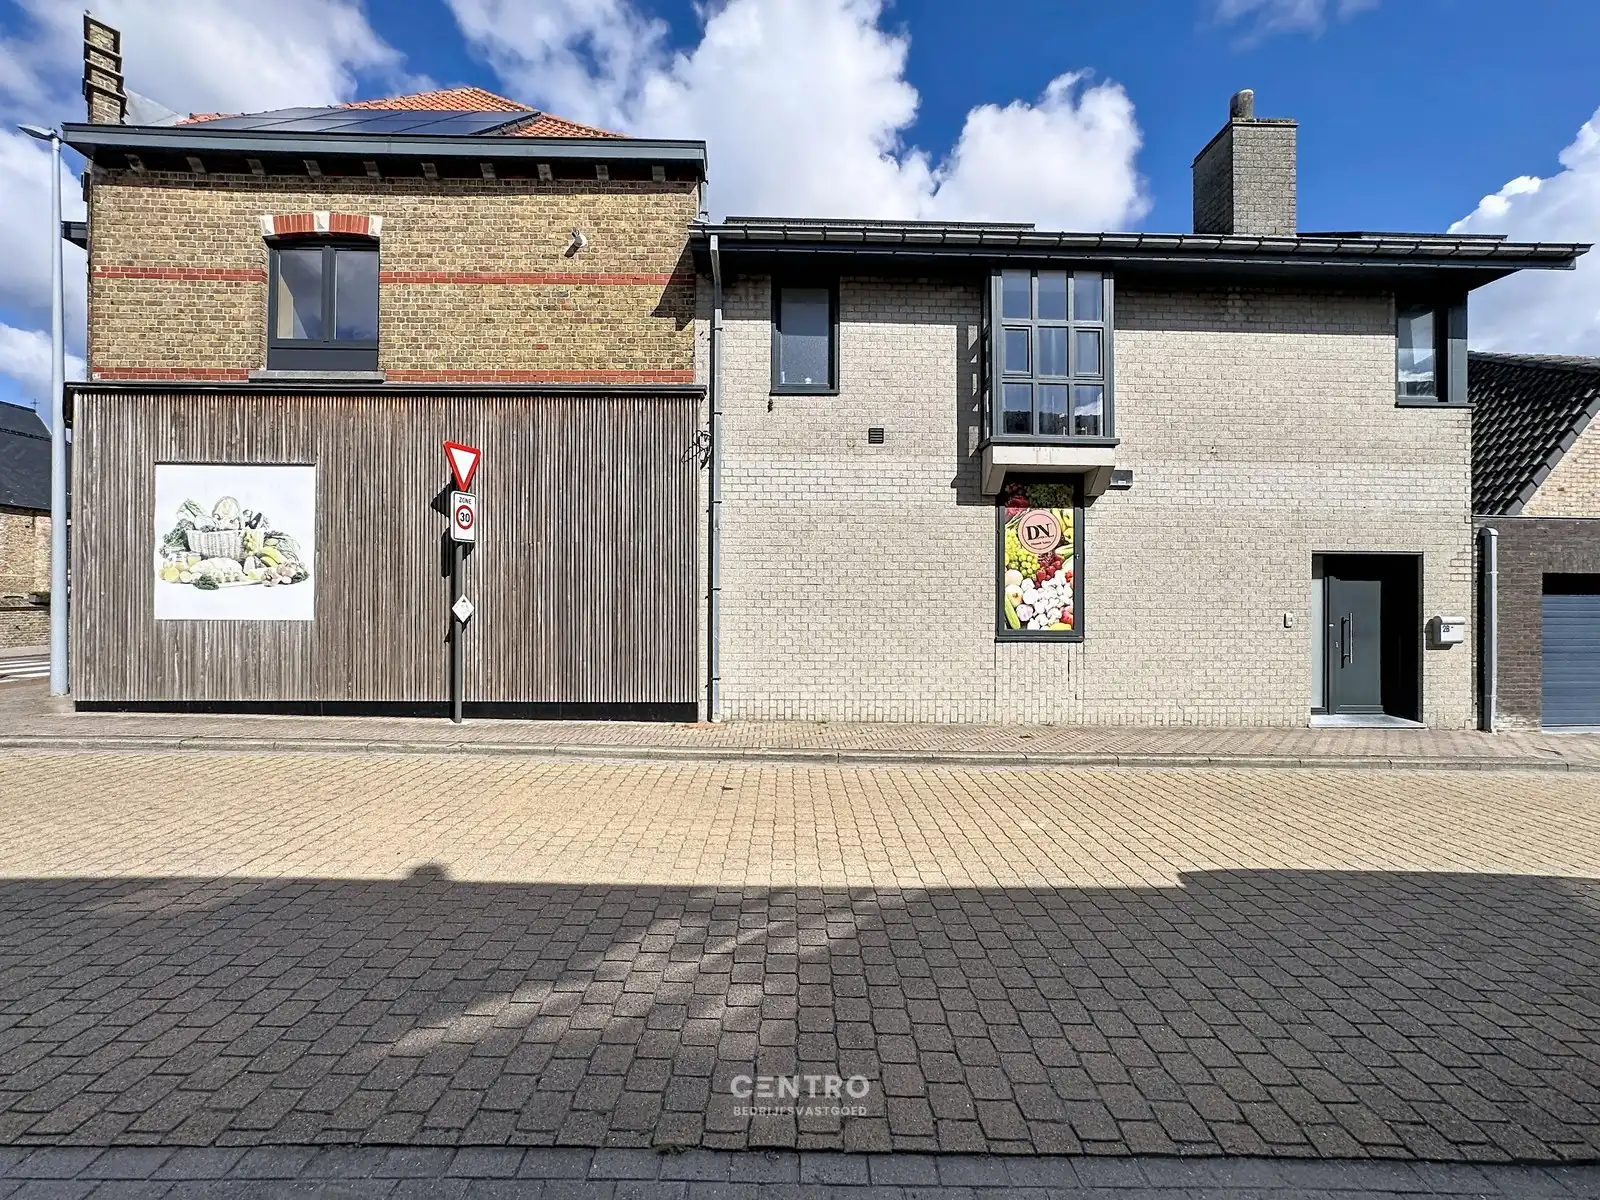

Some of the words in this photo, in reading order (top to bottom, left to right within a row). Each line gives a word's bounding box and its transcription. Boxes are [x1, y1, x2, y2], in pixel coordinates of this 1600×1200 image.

[459, 496, 472, 505] ZONE
[460, 512, 470, 523] 30
[1025, 523, 1053, 541] DN
